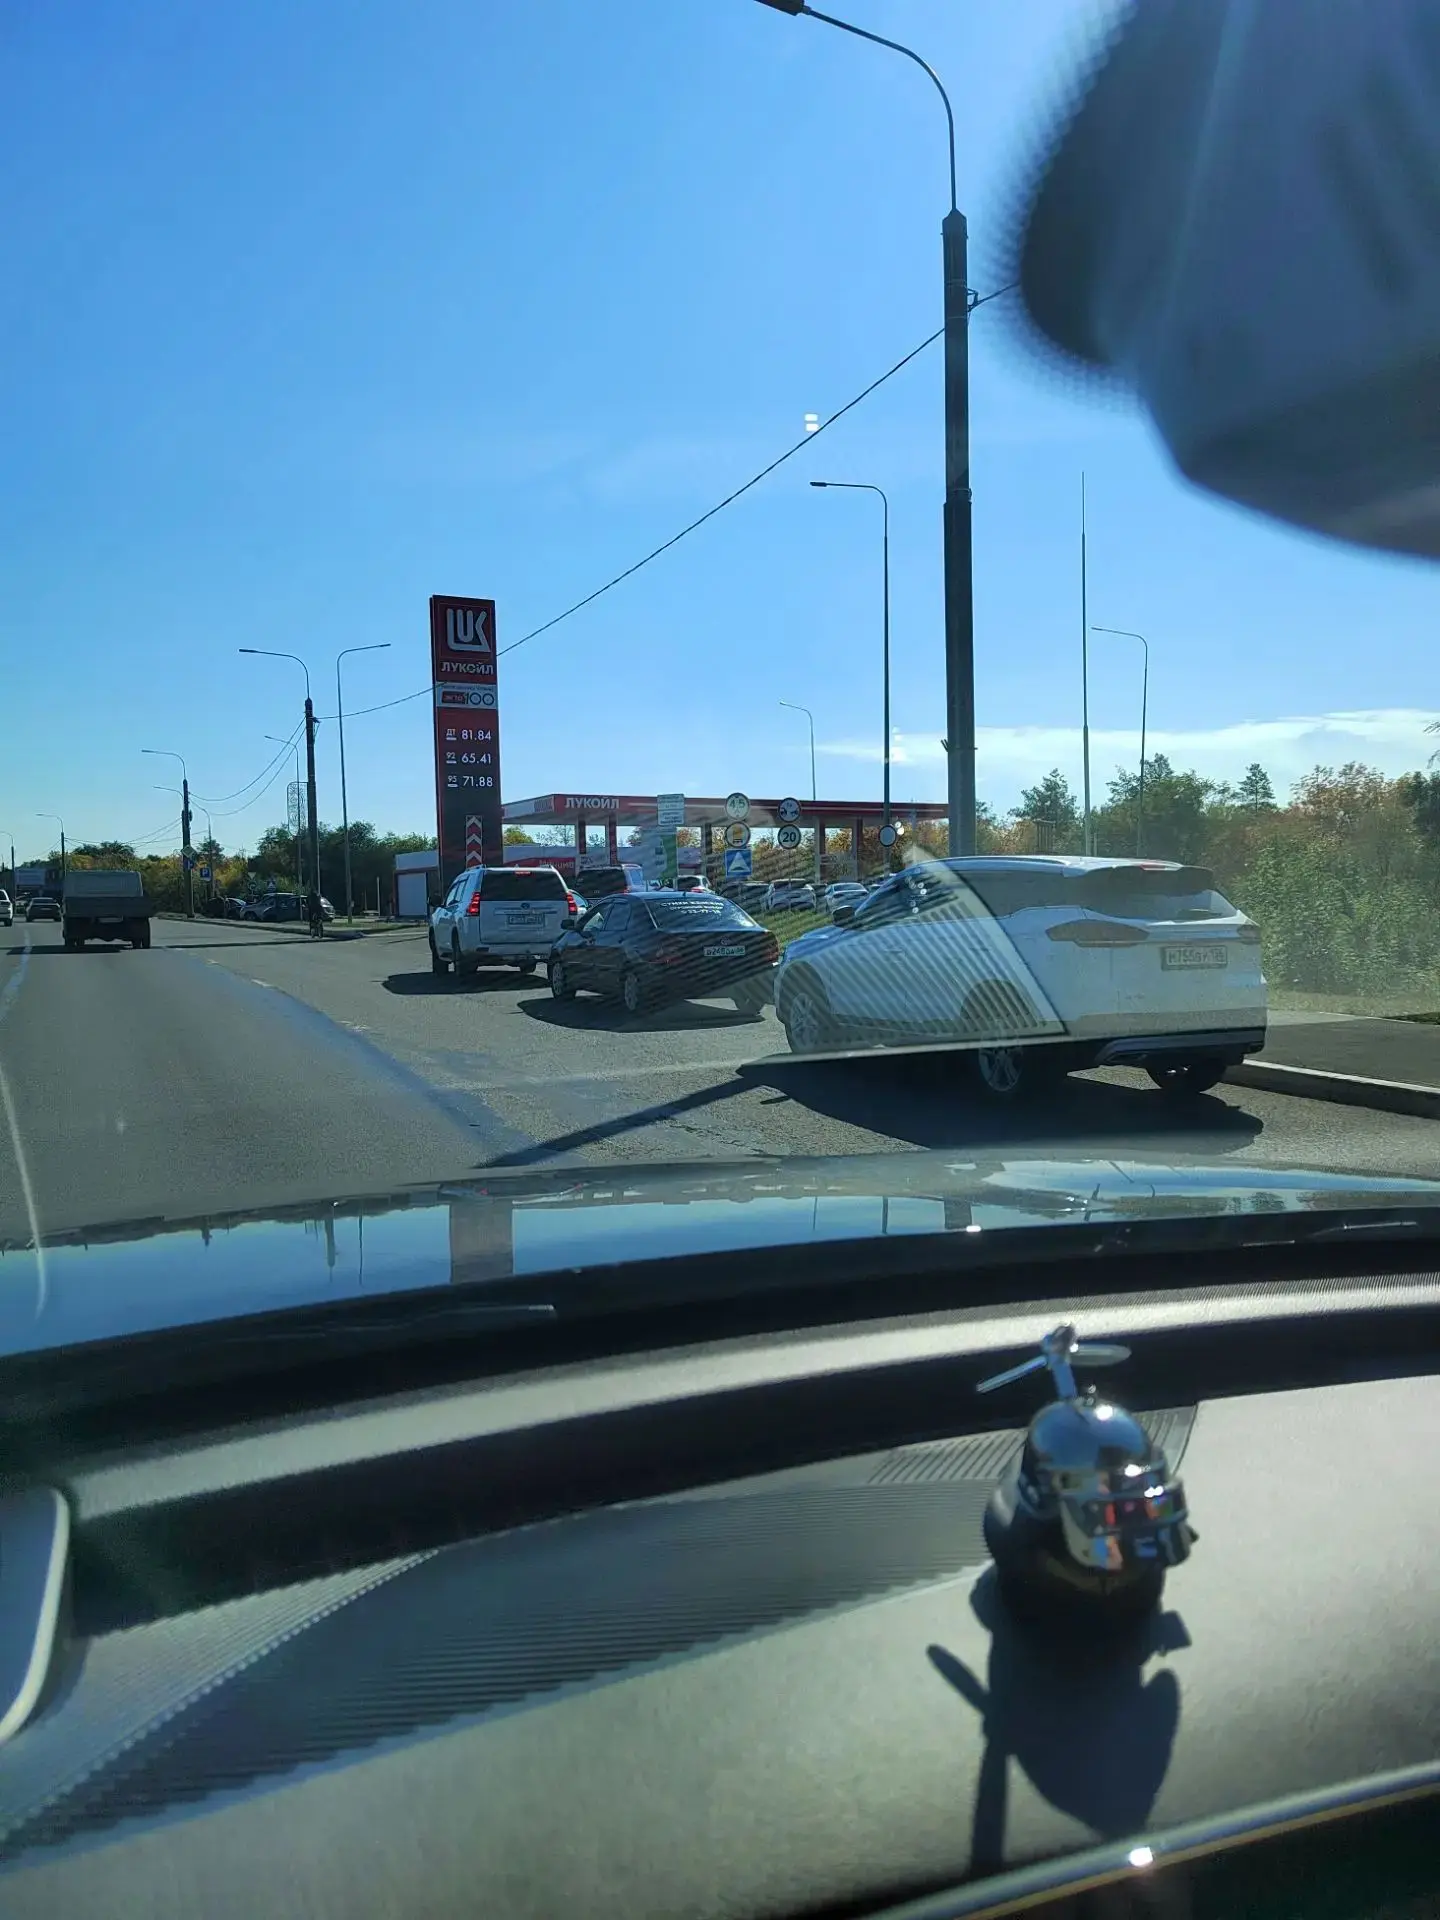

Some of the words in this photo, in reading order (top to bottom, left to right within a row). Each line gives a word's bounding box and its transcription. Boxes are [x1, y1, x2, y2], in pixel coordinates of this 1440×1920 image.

[441, 661, 494, 675] ЛУКОЙЛ
[461, 729, 492, 740] 81.84
[446, 751, 456, 760] 92
[461, 752, 492, 764] 65.41
[462, 775, 493, 787] 71.88
[565, 796, 620, 809] ЛУКОЙЛ
[782, 831, 797, 842] 20
